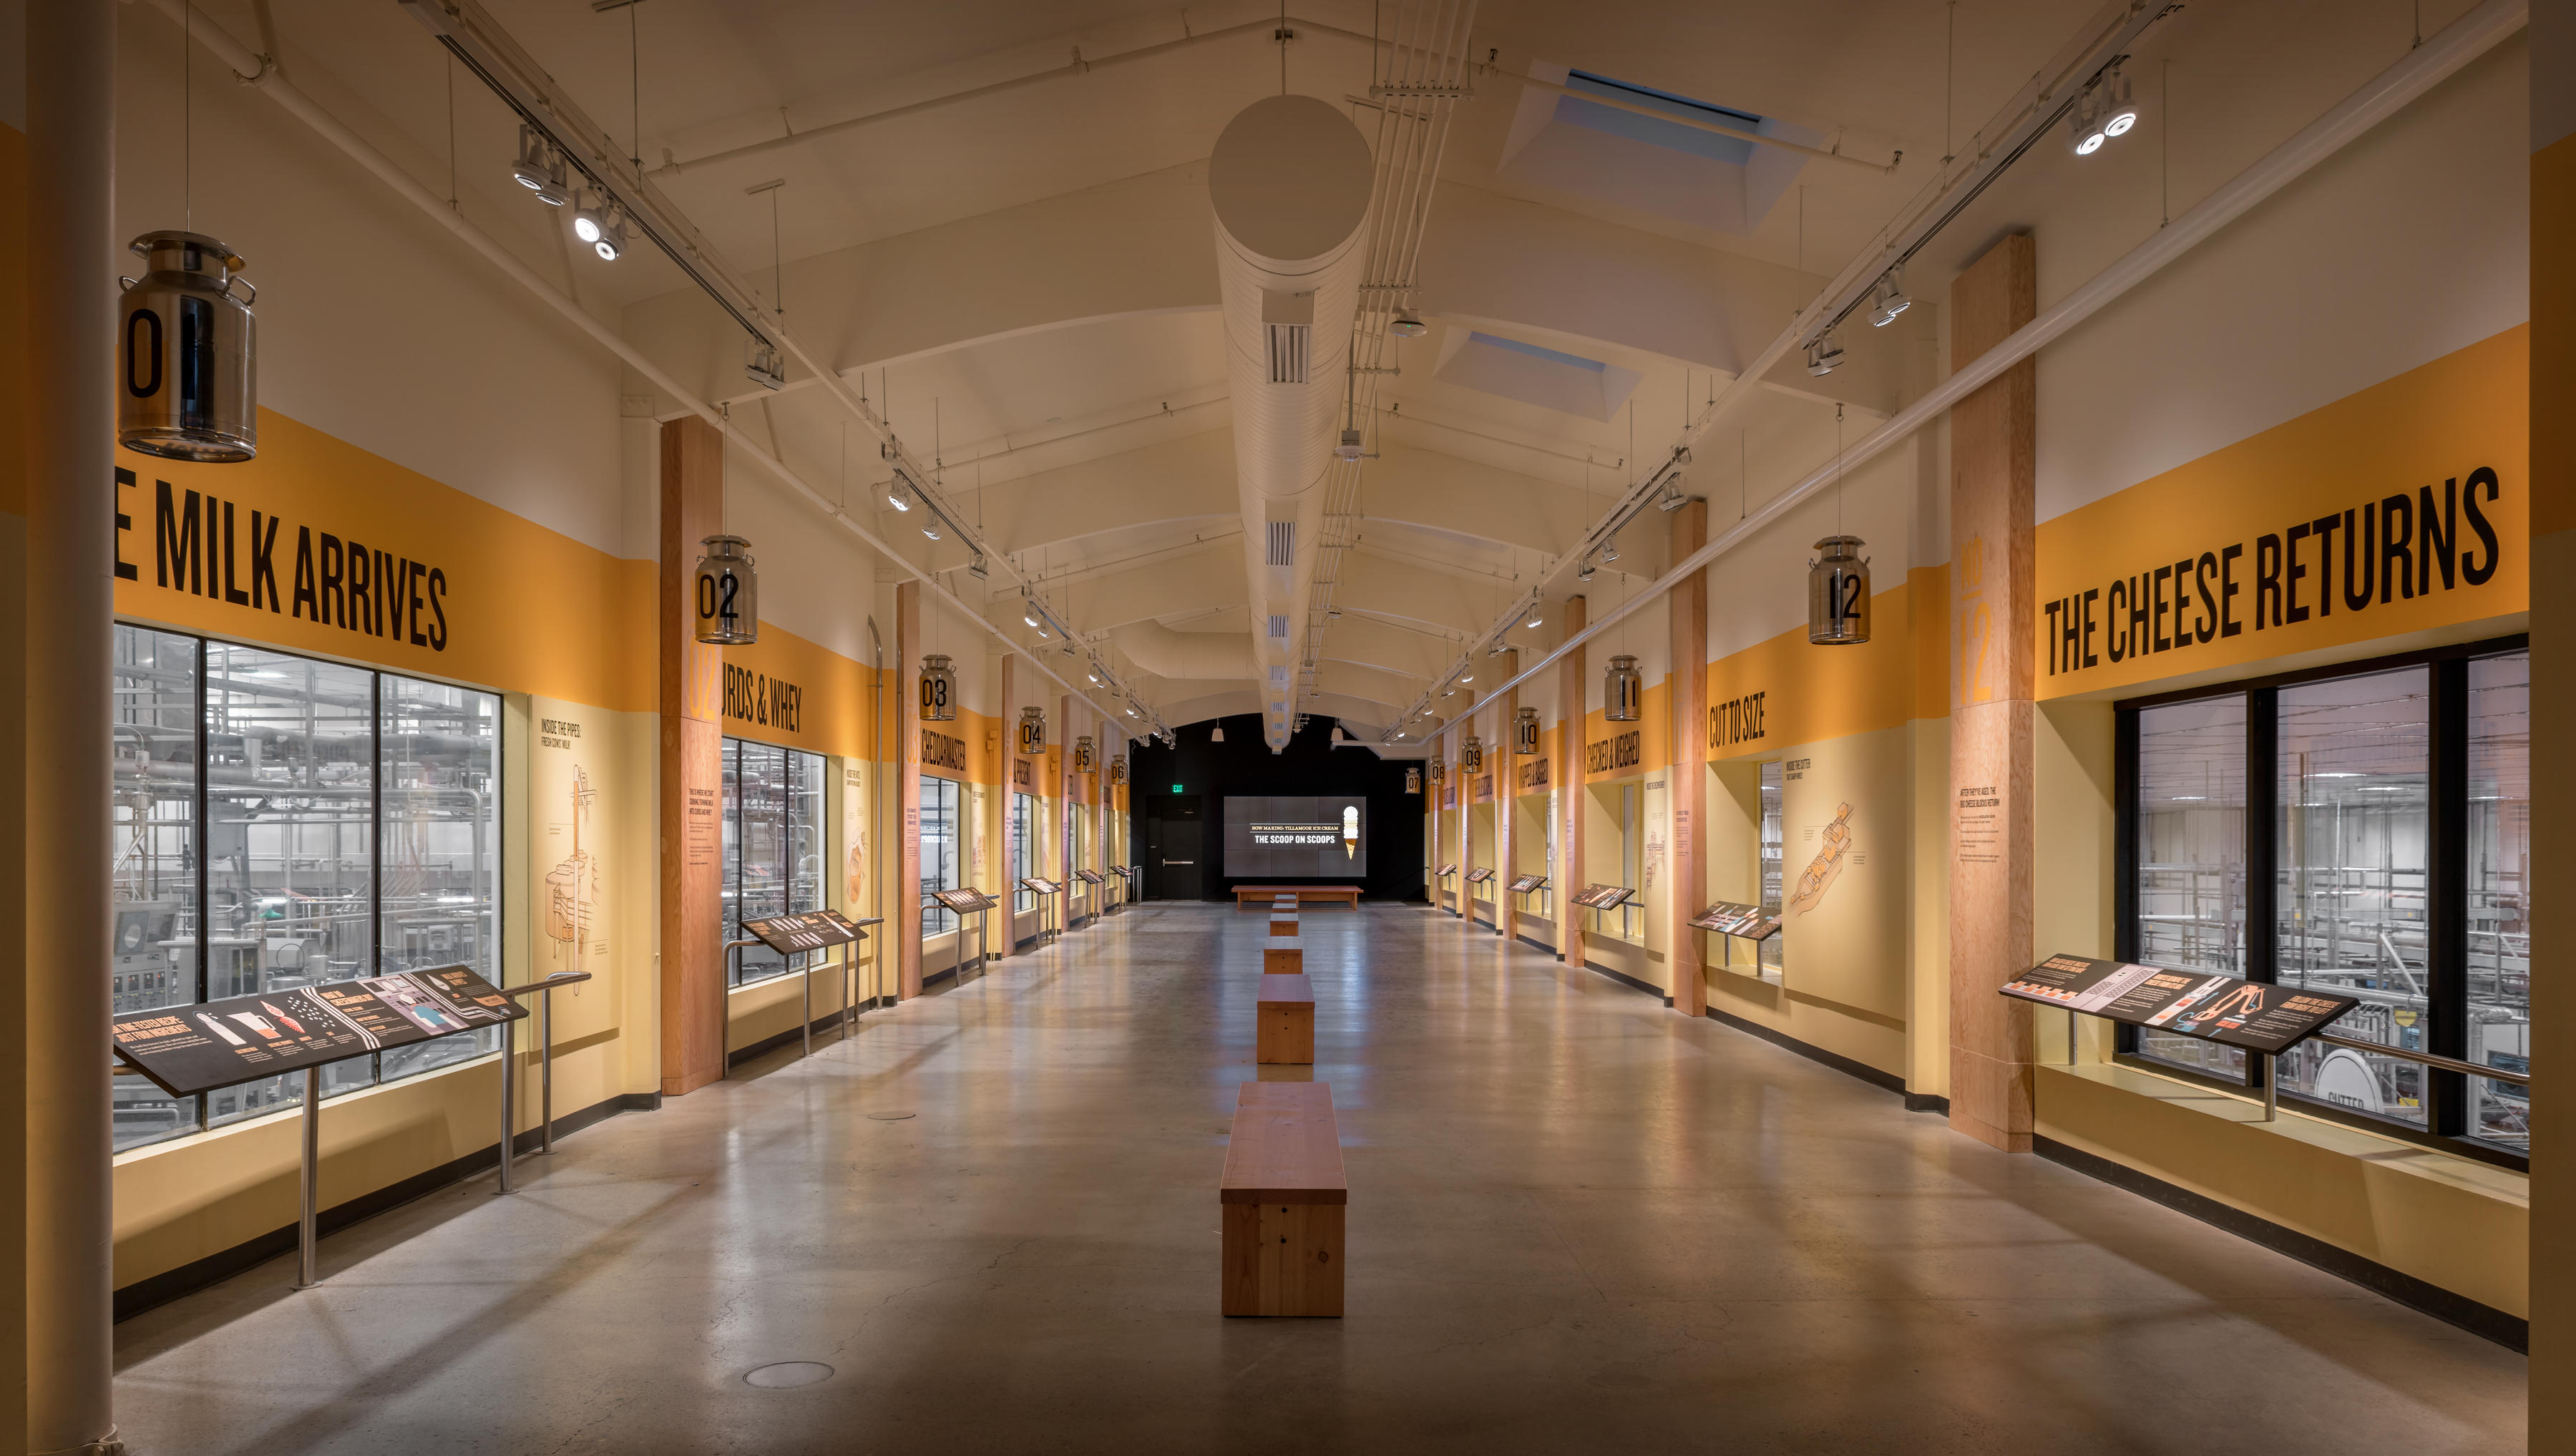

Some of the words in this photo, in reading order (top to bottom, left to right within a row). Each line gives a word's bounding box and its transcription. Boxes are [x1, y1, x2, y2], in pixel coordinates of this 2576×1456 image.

[155, 479, 280, 615] MILK
[293, 525, 447, 653] ARRIVES
[2044, 587, 2098, 677] THE
[2108, 542, 2243, 664] CHEESE
[2255, 465, 2500, 631] RETURNS
[700, 574, 738, 619] 02
[1829, 574, 1862, 619] 12
[1961, 601, 1992, 705] 12
[722, 662, 753, 722] URDS
[757, 673, 768, 726] &
[770, 677, 802, 733] WHEY
[922, 679, 947, 707] 03
[1621, 680, 1636, 707] 11
[541, 718, 557, 735] INSIDE
[557, 720, 567, 736] THE
[1709, 703, 1727, 749] CUT
[1729, 698, 1741, 745] TO
[1743, 691, 1765, 741] SIZE
[1023, 724, 1041, 745] 04
[1521, 724, 1537, 744] 10
[922, 728, 966, 772] CHEDDARMASTER
[1075, 750, 1089, 766] 05
[1466, 750, 1480, 766] 09
[1586, 739, 1609, 776] CHECKED
[1609, 737, 1614, 771] &
[1614, 730, 1640, 769] WEIGHED
[1112, 766, 1124, 779] 06
[1408, 777, 1419, 789] 07
[1432, 766, 1445, 779] 08
[1174, 784, 1183, 793] EXIT
[1254, 835, 1269, 844] THE
[1270, 835, 1294, 844] SCOOP
[1295, 835, 1306, 844] ON
[1307, 835, 1335, 844] SCOOPS
